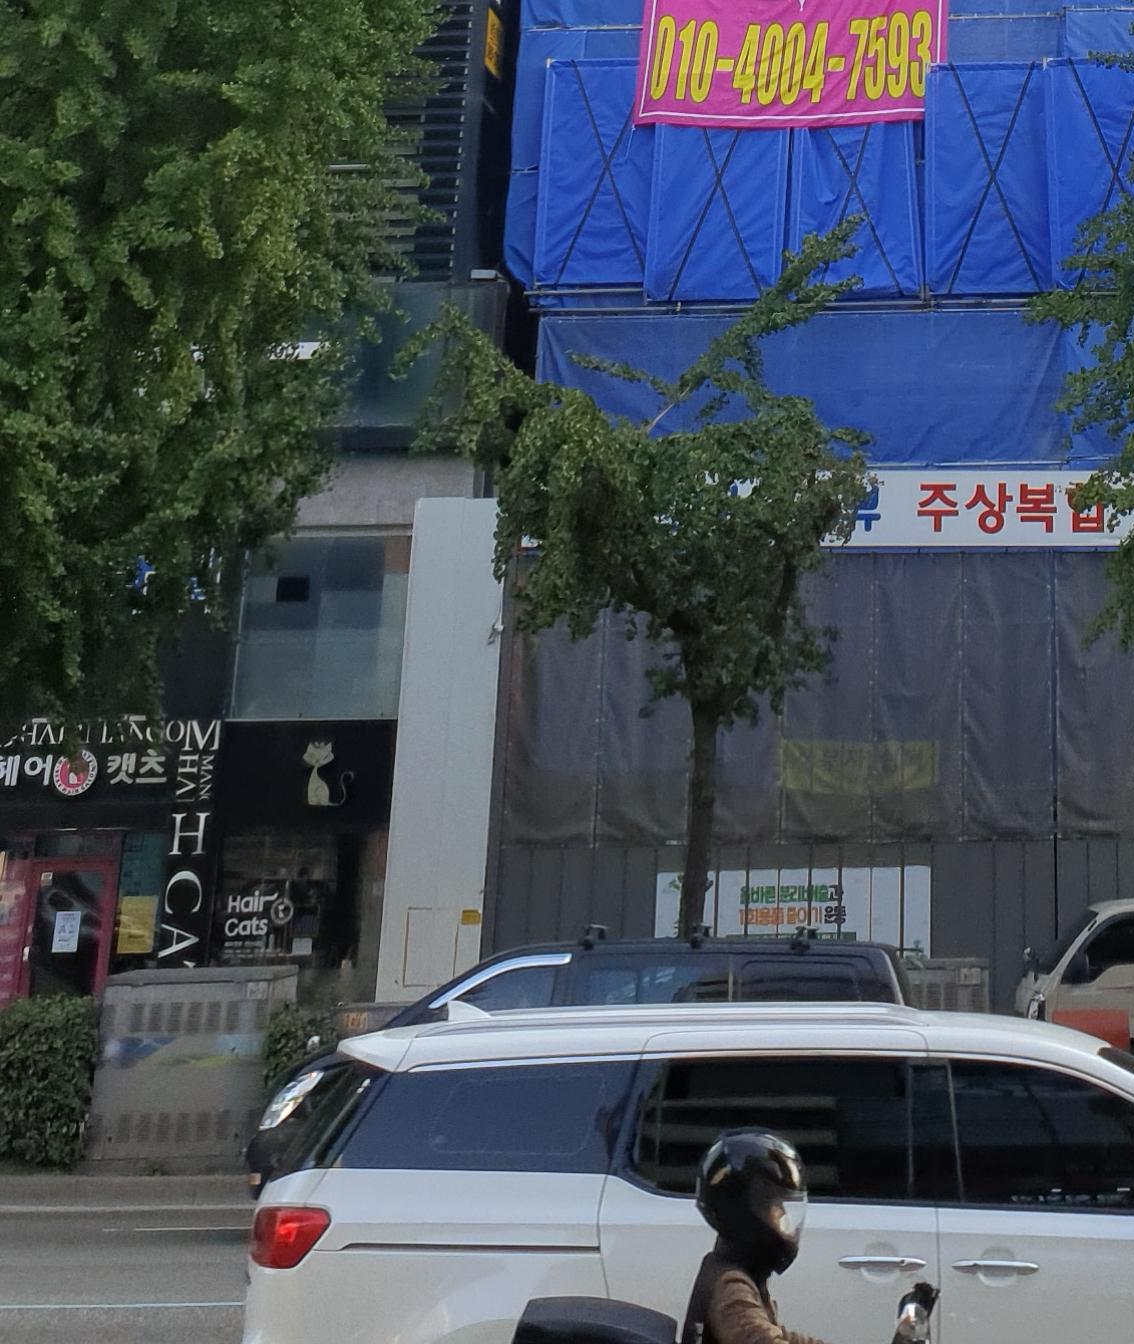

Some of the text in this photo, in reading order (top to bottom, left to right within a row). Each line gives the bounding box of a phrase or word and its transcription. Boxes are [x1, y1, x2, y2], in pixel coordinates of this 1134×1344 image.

[649, 9, 932, 107] 010-4004-7593
[227, 890, 279, 913] Hair
[225, 916, 269, 936] Cats
